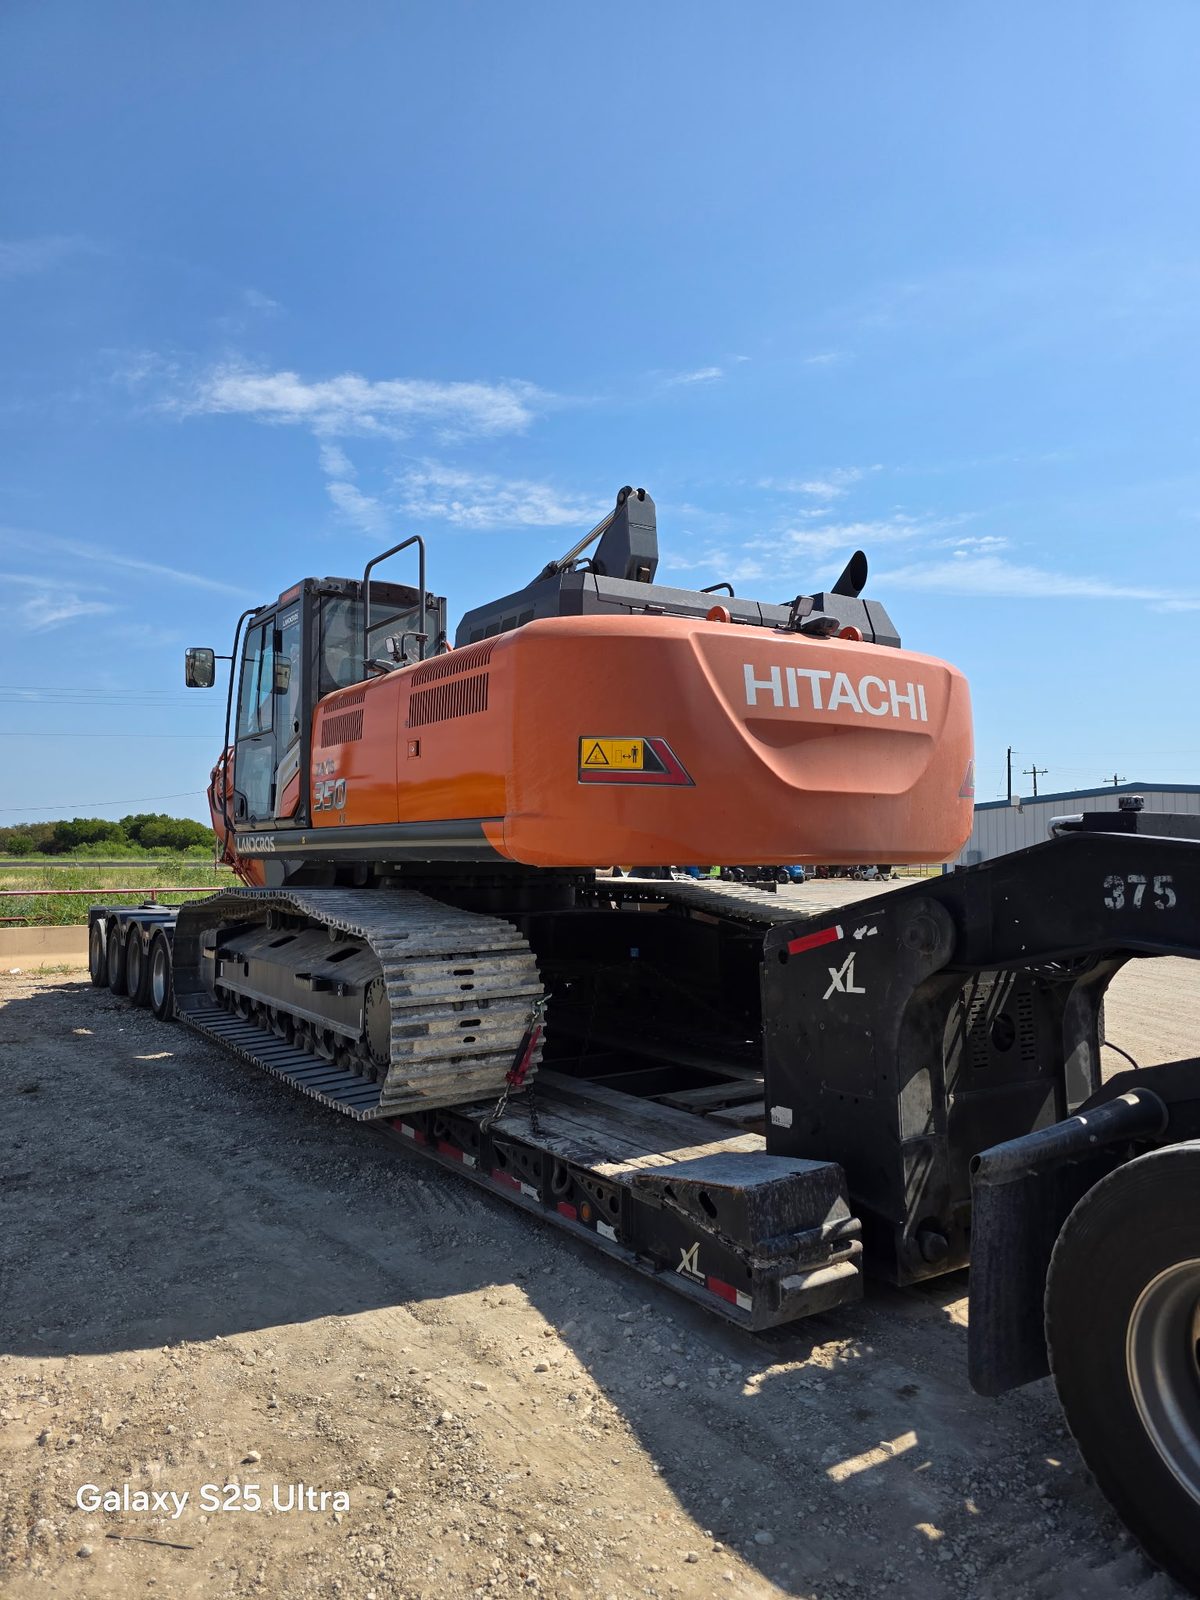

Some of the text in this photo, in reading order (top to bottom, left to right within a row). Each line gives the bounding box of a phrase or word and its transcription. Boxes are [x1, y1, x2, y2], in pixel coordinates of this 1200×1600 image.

[743, 663, 928, 722] HITACHI
[314, 778, 347, 812] 350
[237, 836, 276, 852] LANDCROS
[1103, 874, 1177, 910] 375
[822, 951, 866, 1000] XL
[675, 1241, 706, 1279] XL
